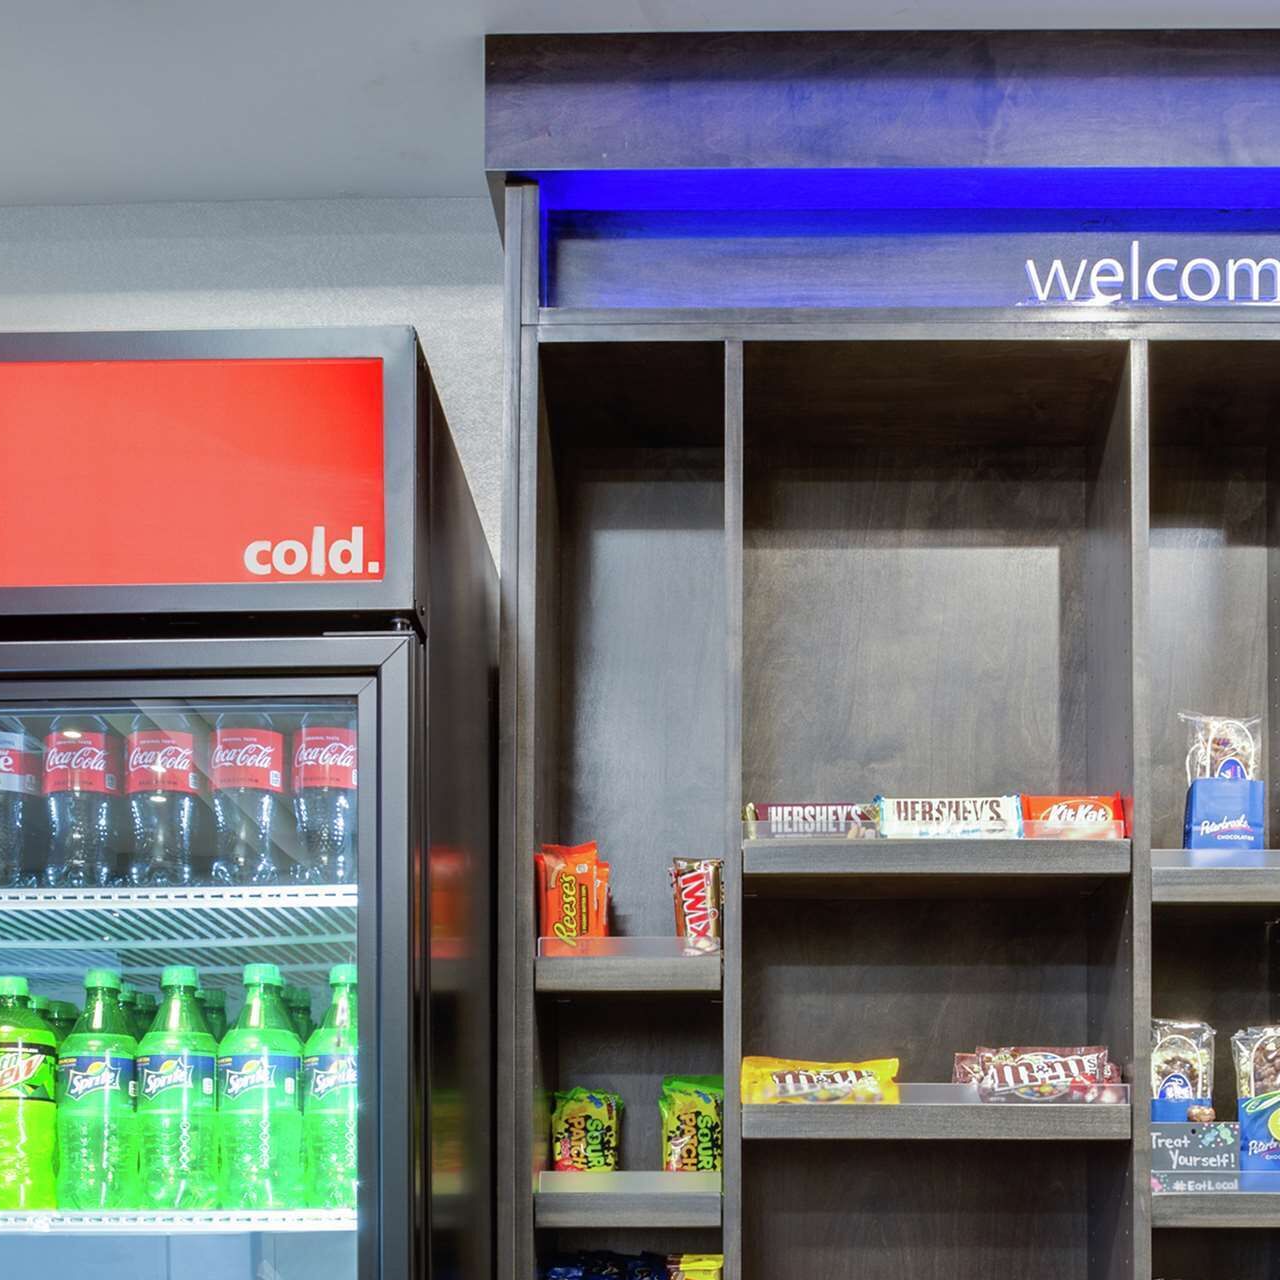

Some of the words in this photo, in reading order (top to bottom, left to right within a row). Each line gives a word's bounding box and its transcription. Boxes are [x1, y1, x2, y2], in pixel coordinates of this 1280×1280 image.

[243, 525, 380, 577] cold.
[46, 746, 108, 772] Coca-Cola
[129, 746, 193, 771] Coca-Cola
[213, 744, 275, 769] Coca-Cola
[770, 805, 862, 833] HERSHEY'S
[895, 800, 1001, 822] HERSHEY'S
[553, 874, 577, 947] Reese's
[587, 1119, 605, 1168] SOUR
[696, 1115, 715, 1169] SOUR
[1150, 1132, 1190, 1148] Treat
[1169, 1150, 1235, 1169] Yourself!
[1172, 1178, 1239, 1192] #EatLocal
